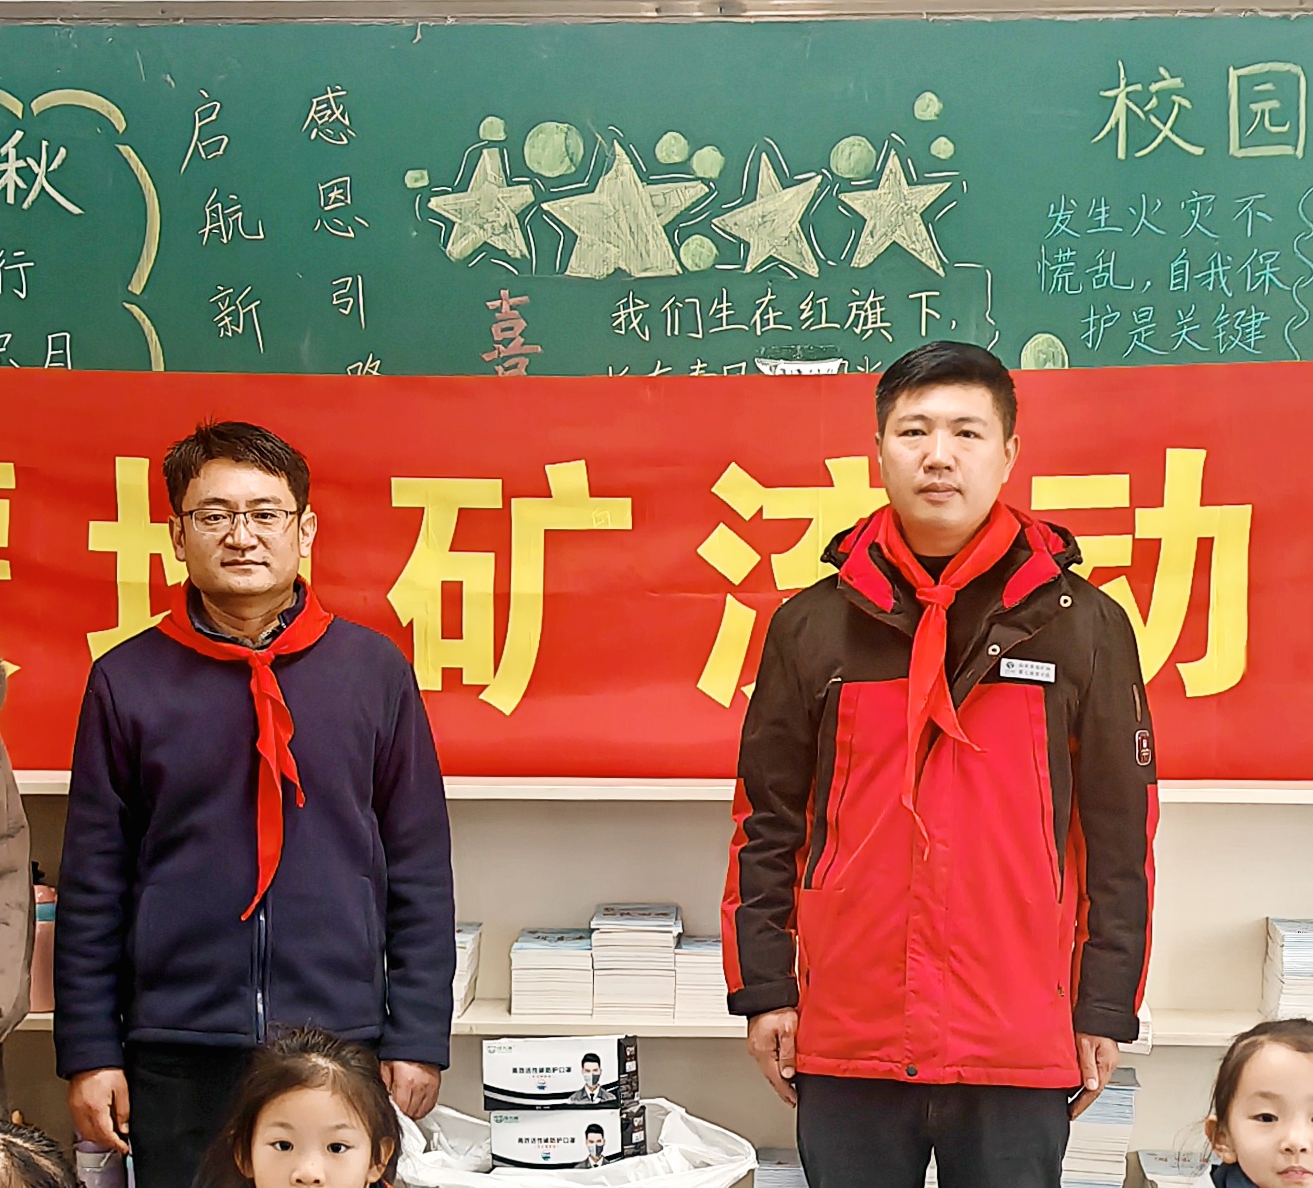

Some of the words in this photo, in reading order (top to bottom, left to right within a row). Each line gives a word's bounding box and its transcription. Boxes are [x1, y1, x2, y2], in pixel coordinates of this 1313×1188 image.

[181, 90, 265, 353] 启航新
[1044, 190, 1274, 239] 发生火灾不
[481, 288, 543, 376] 喜
[1080, 303, 1271, 358] 护是关键
